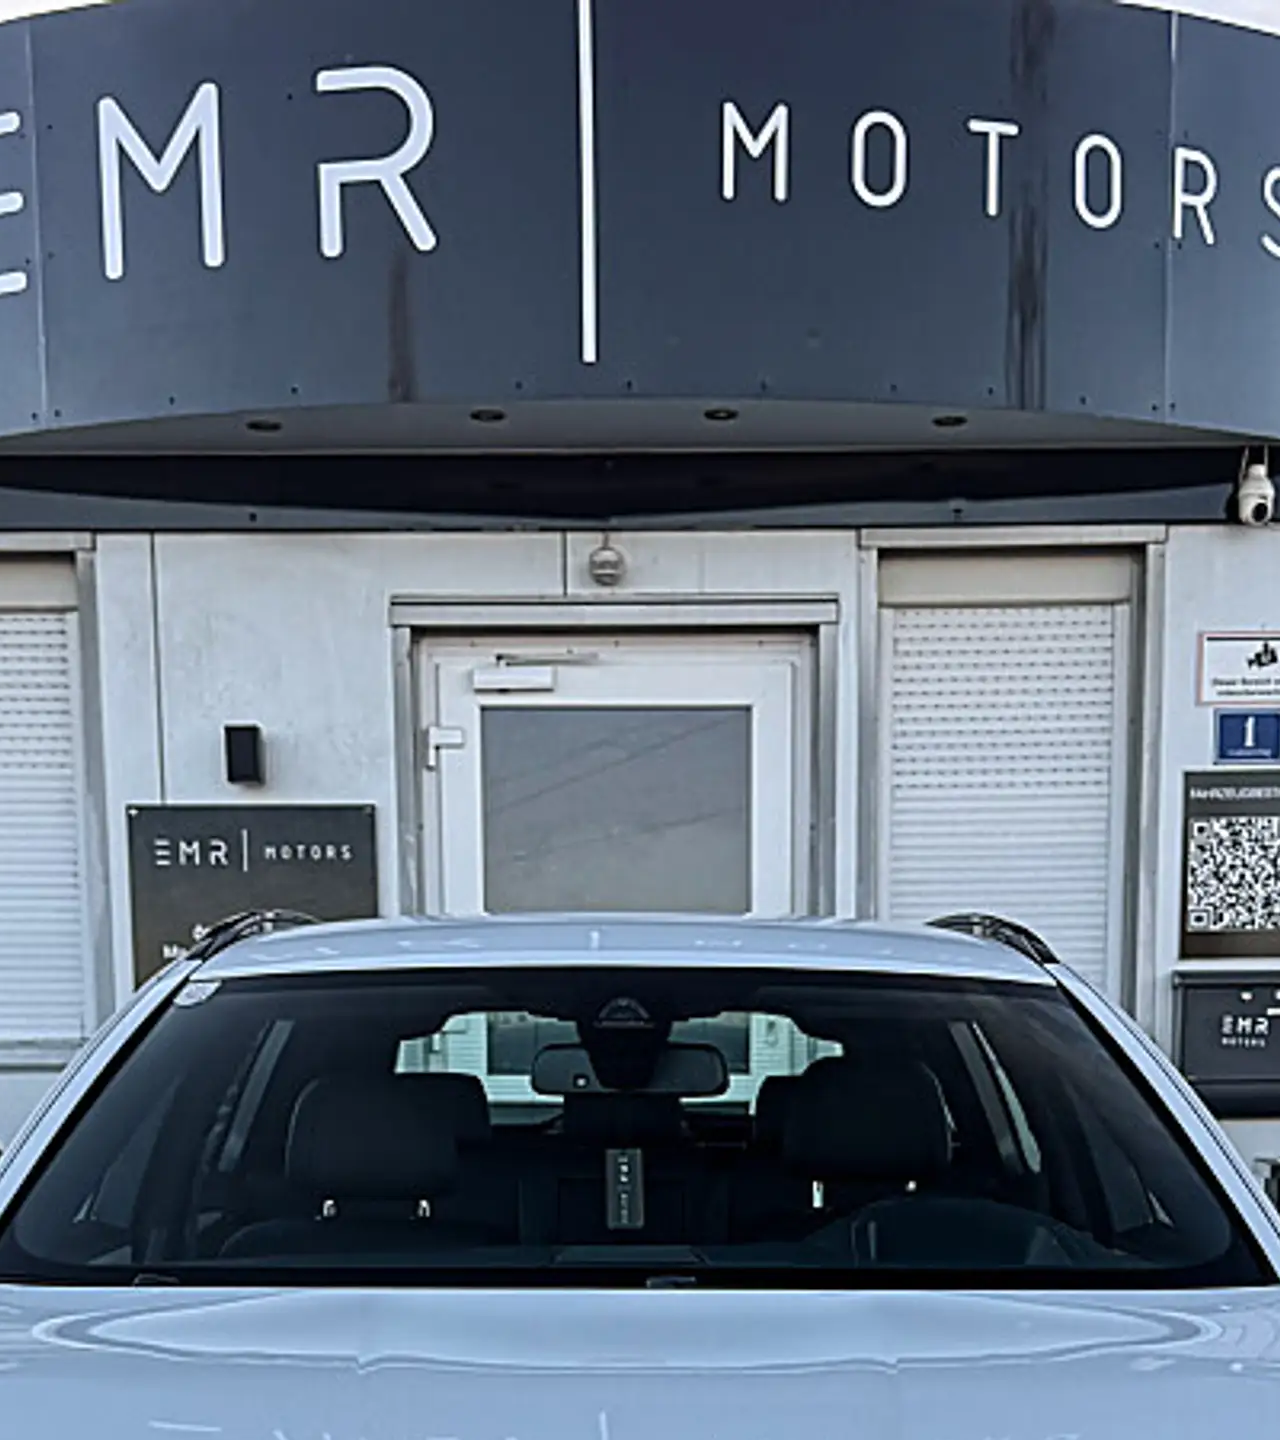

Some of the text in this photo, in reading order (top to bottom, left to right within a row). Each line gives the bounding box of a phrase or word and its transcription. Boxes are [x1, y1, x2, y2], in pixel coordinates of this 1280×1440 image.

[153, 838, 352, 867] EMR MOTORS
[1221, 1014, 1269, 1035] EMR
